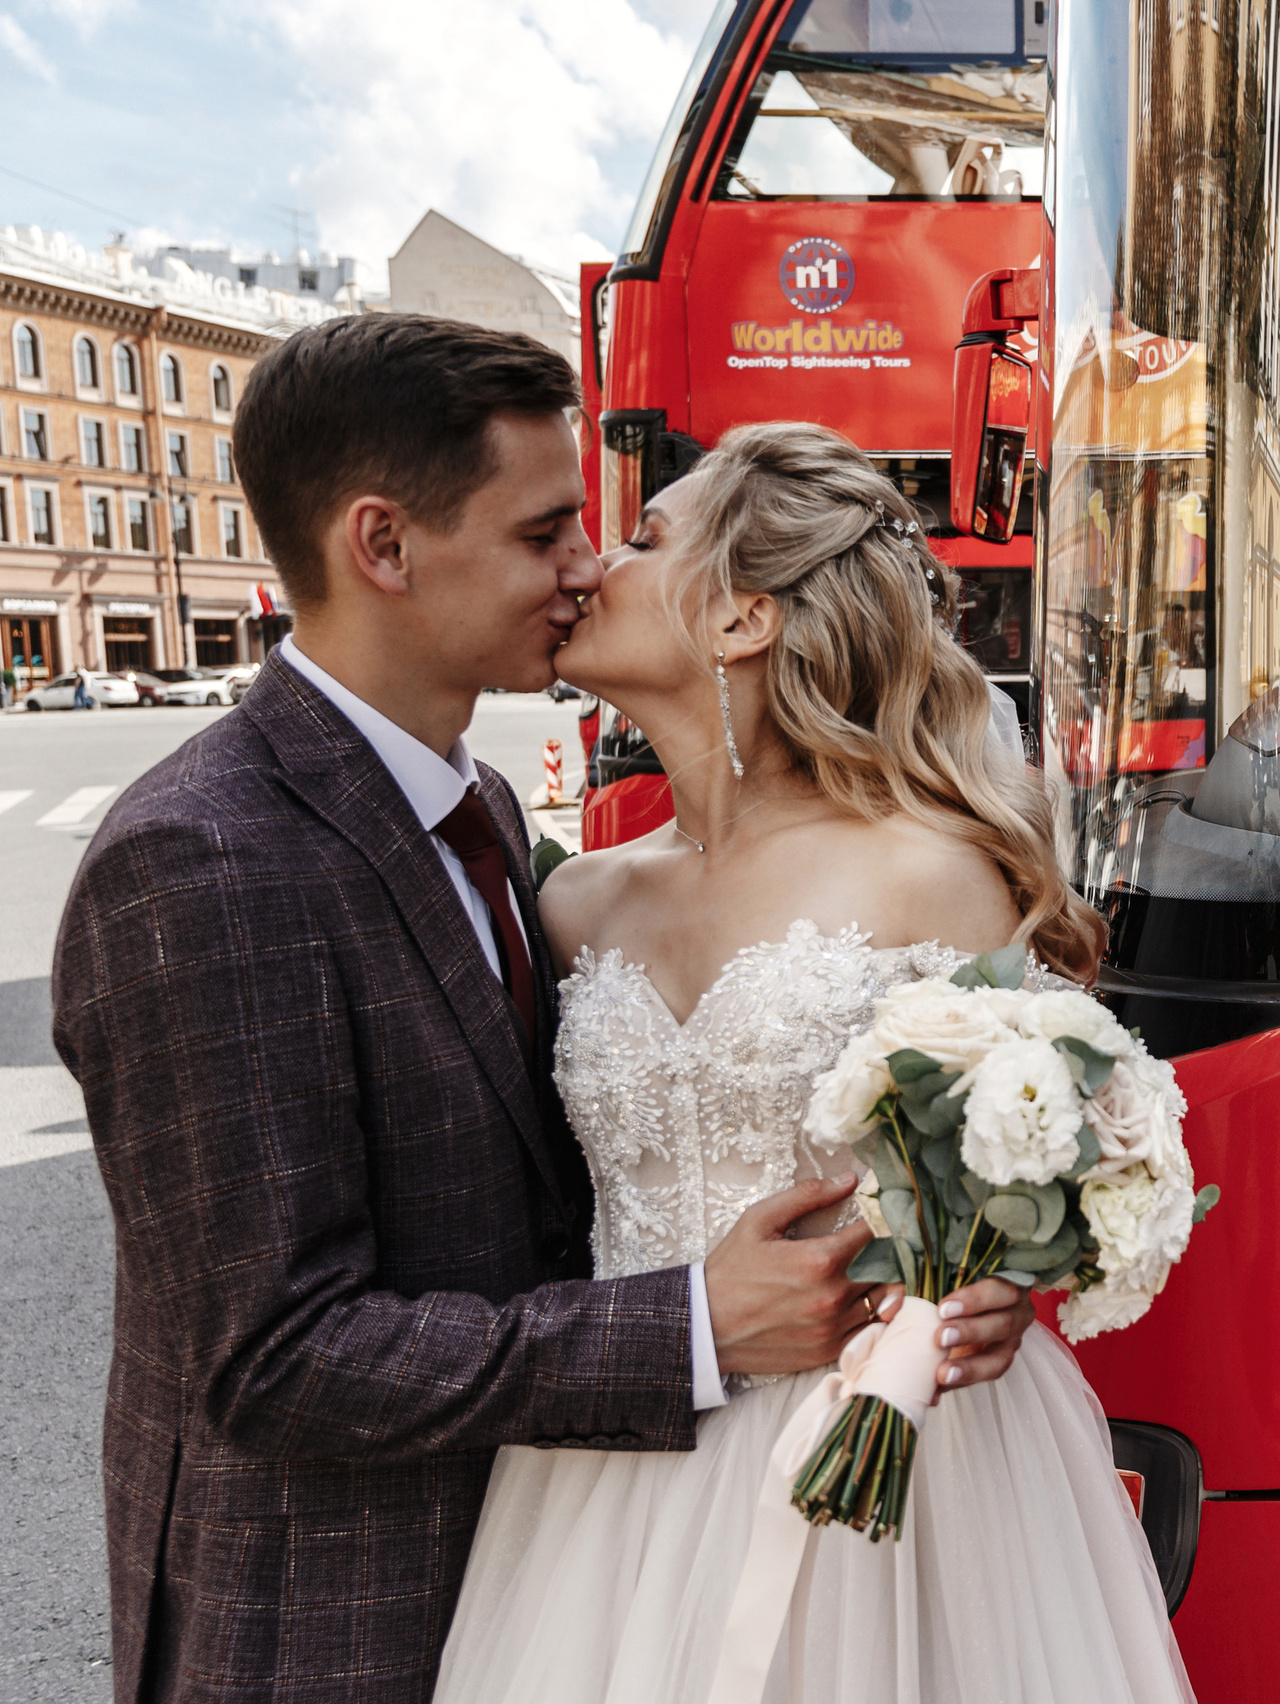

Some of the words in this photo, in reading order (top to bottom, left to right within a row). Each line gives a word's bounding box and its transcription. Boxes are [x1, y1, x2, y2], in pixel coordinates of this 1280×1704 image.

[791, 297, 843, 314] Operator
[732, 319, 904, 353] Worldwide
[727, 355, 788, 369] OpenTop
[790, 355, 871, 369] Sightseeing
[872, 355, 911, 368] Tours
